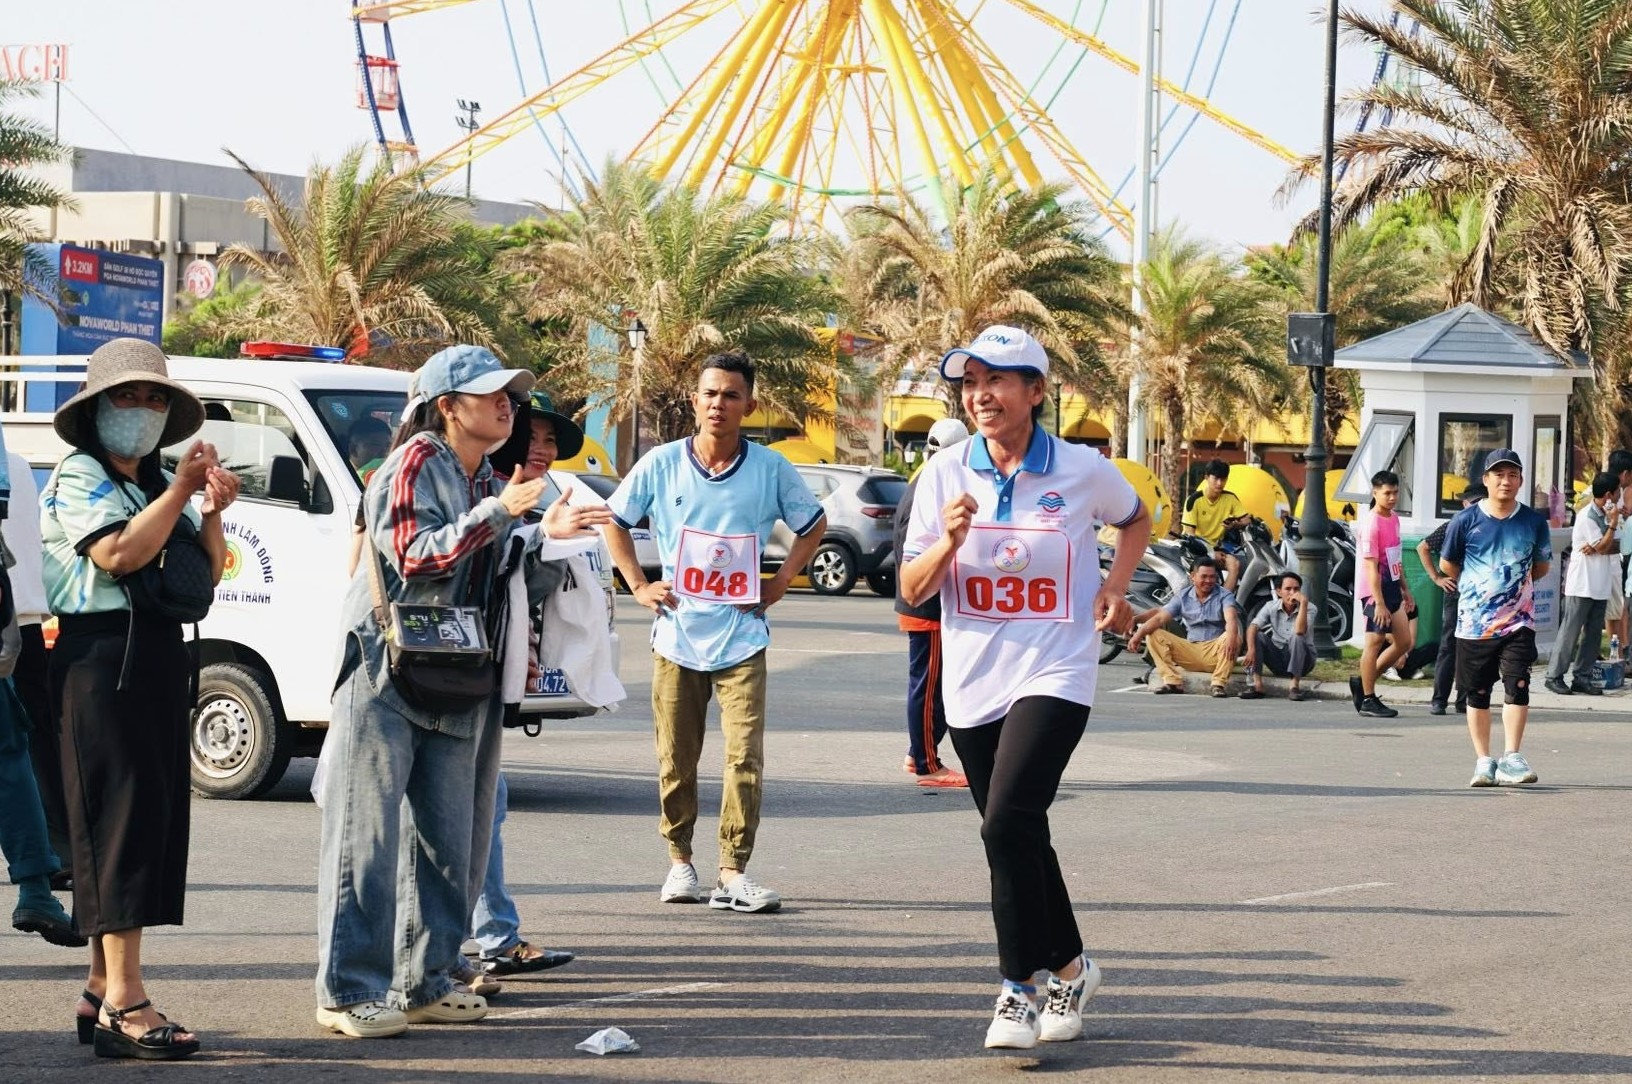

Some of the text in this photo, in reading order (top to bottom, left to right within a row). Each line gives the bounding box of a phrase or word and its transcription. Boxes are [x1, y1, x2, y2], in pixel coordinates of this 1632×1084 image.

[72, 260, 93, 275] 3.2KM
[79, 315, 155, 336] NOVAWORLD PHAN THIET
[684, 567, 748, 597] 048
[965, 576, 1057, 613] 036
[536, 675, 566, 693] 04.72
